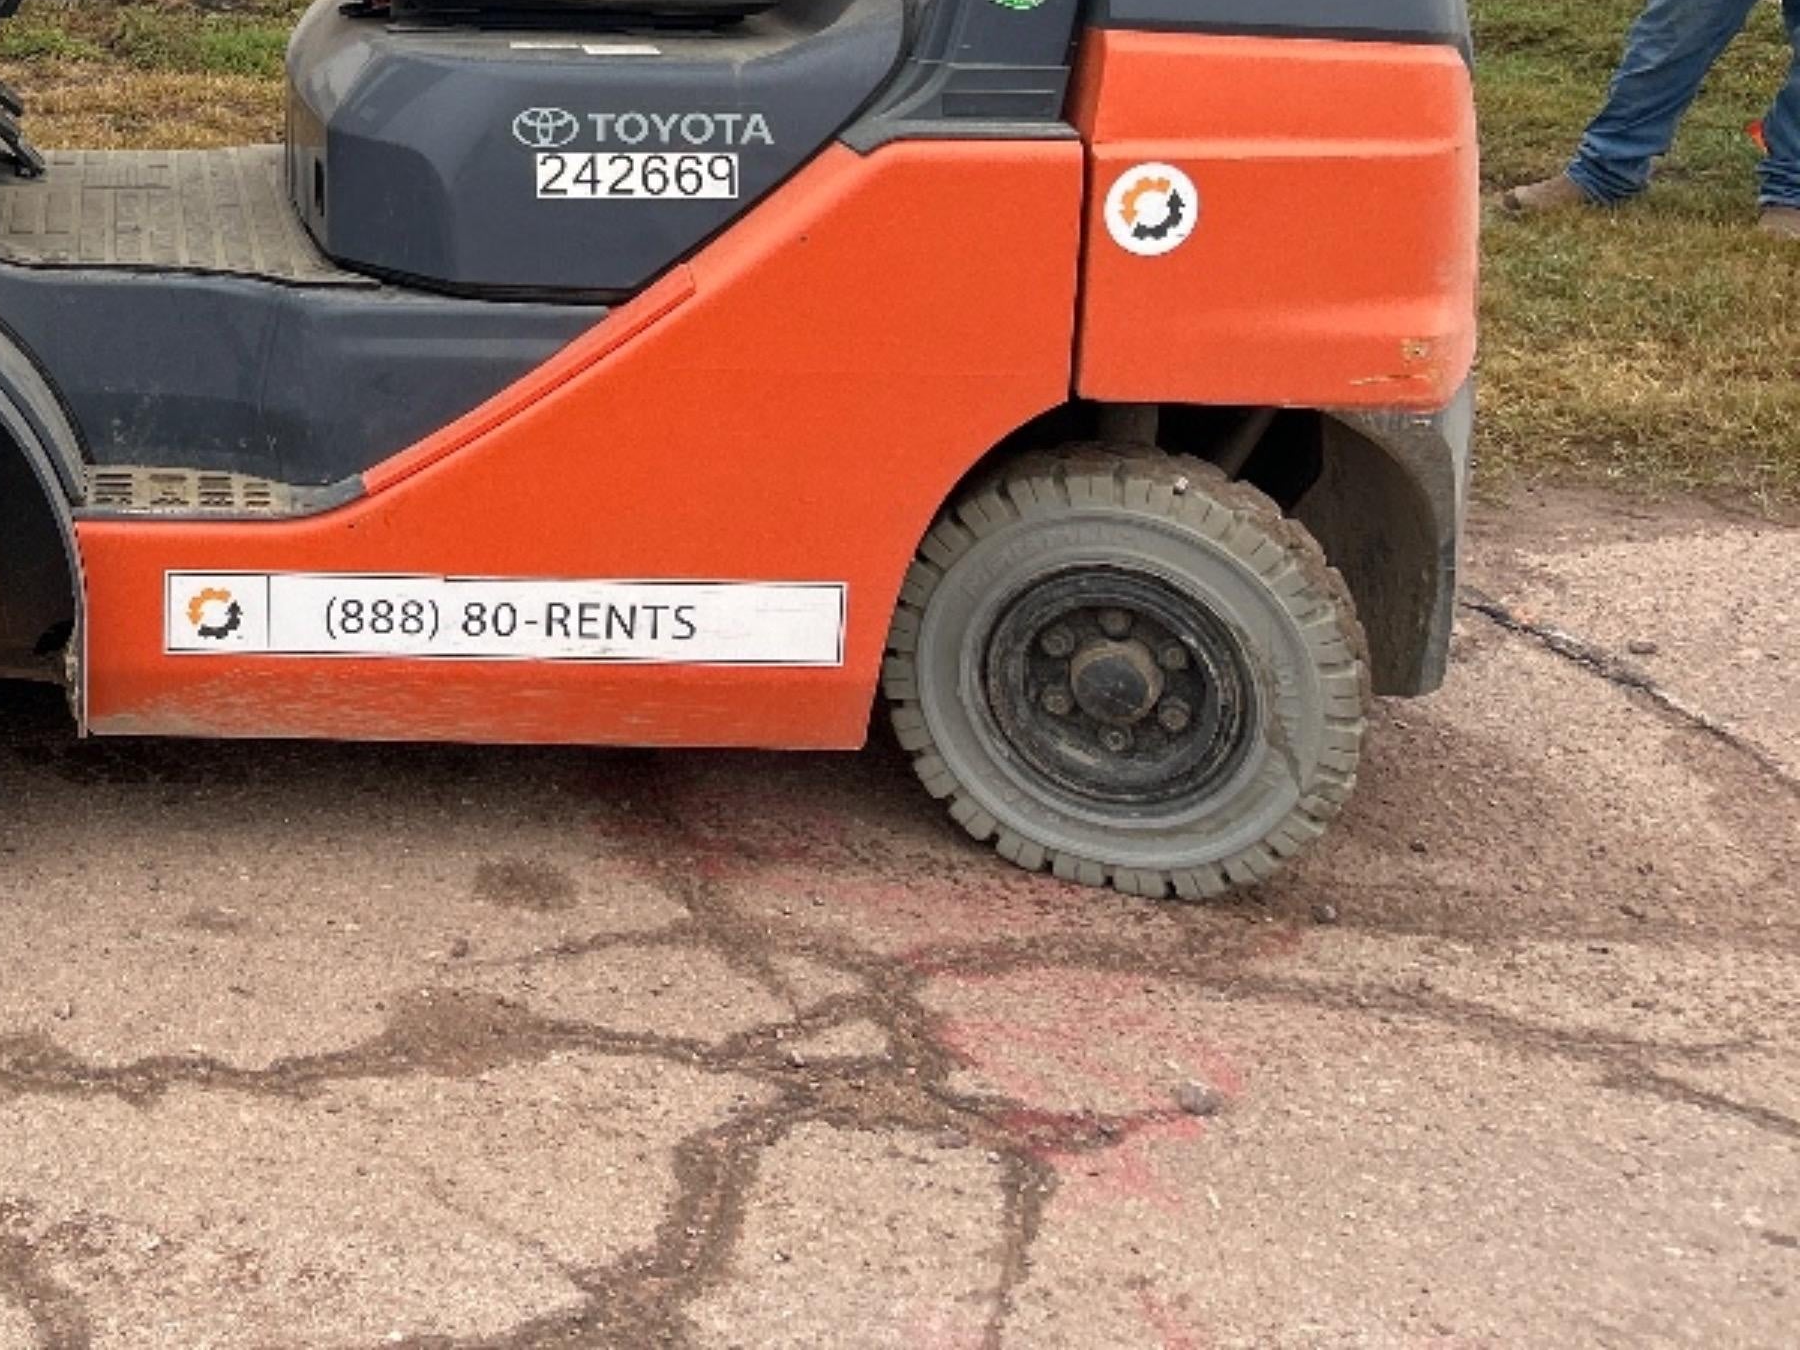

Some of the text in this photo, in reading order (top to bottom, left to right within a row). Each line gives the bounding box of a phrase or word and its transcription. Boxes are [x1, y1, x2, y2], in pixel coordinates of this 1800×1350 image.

[587, 113, 775, 146] TOYOTA
[538, 154, 737, 196] 242669
[324, 596, 698, 642] (888) 80-RENTS
